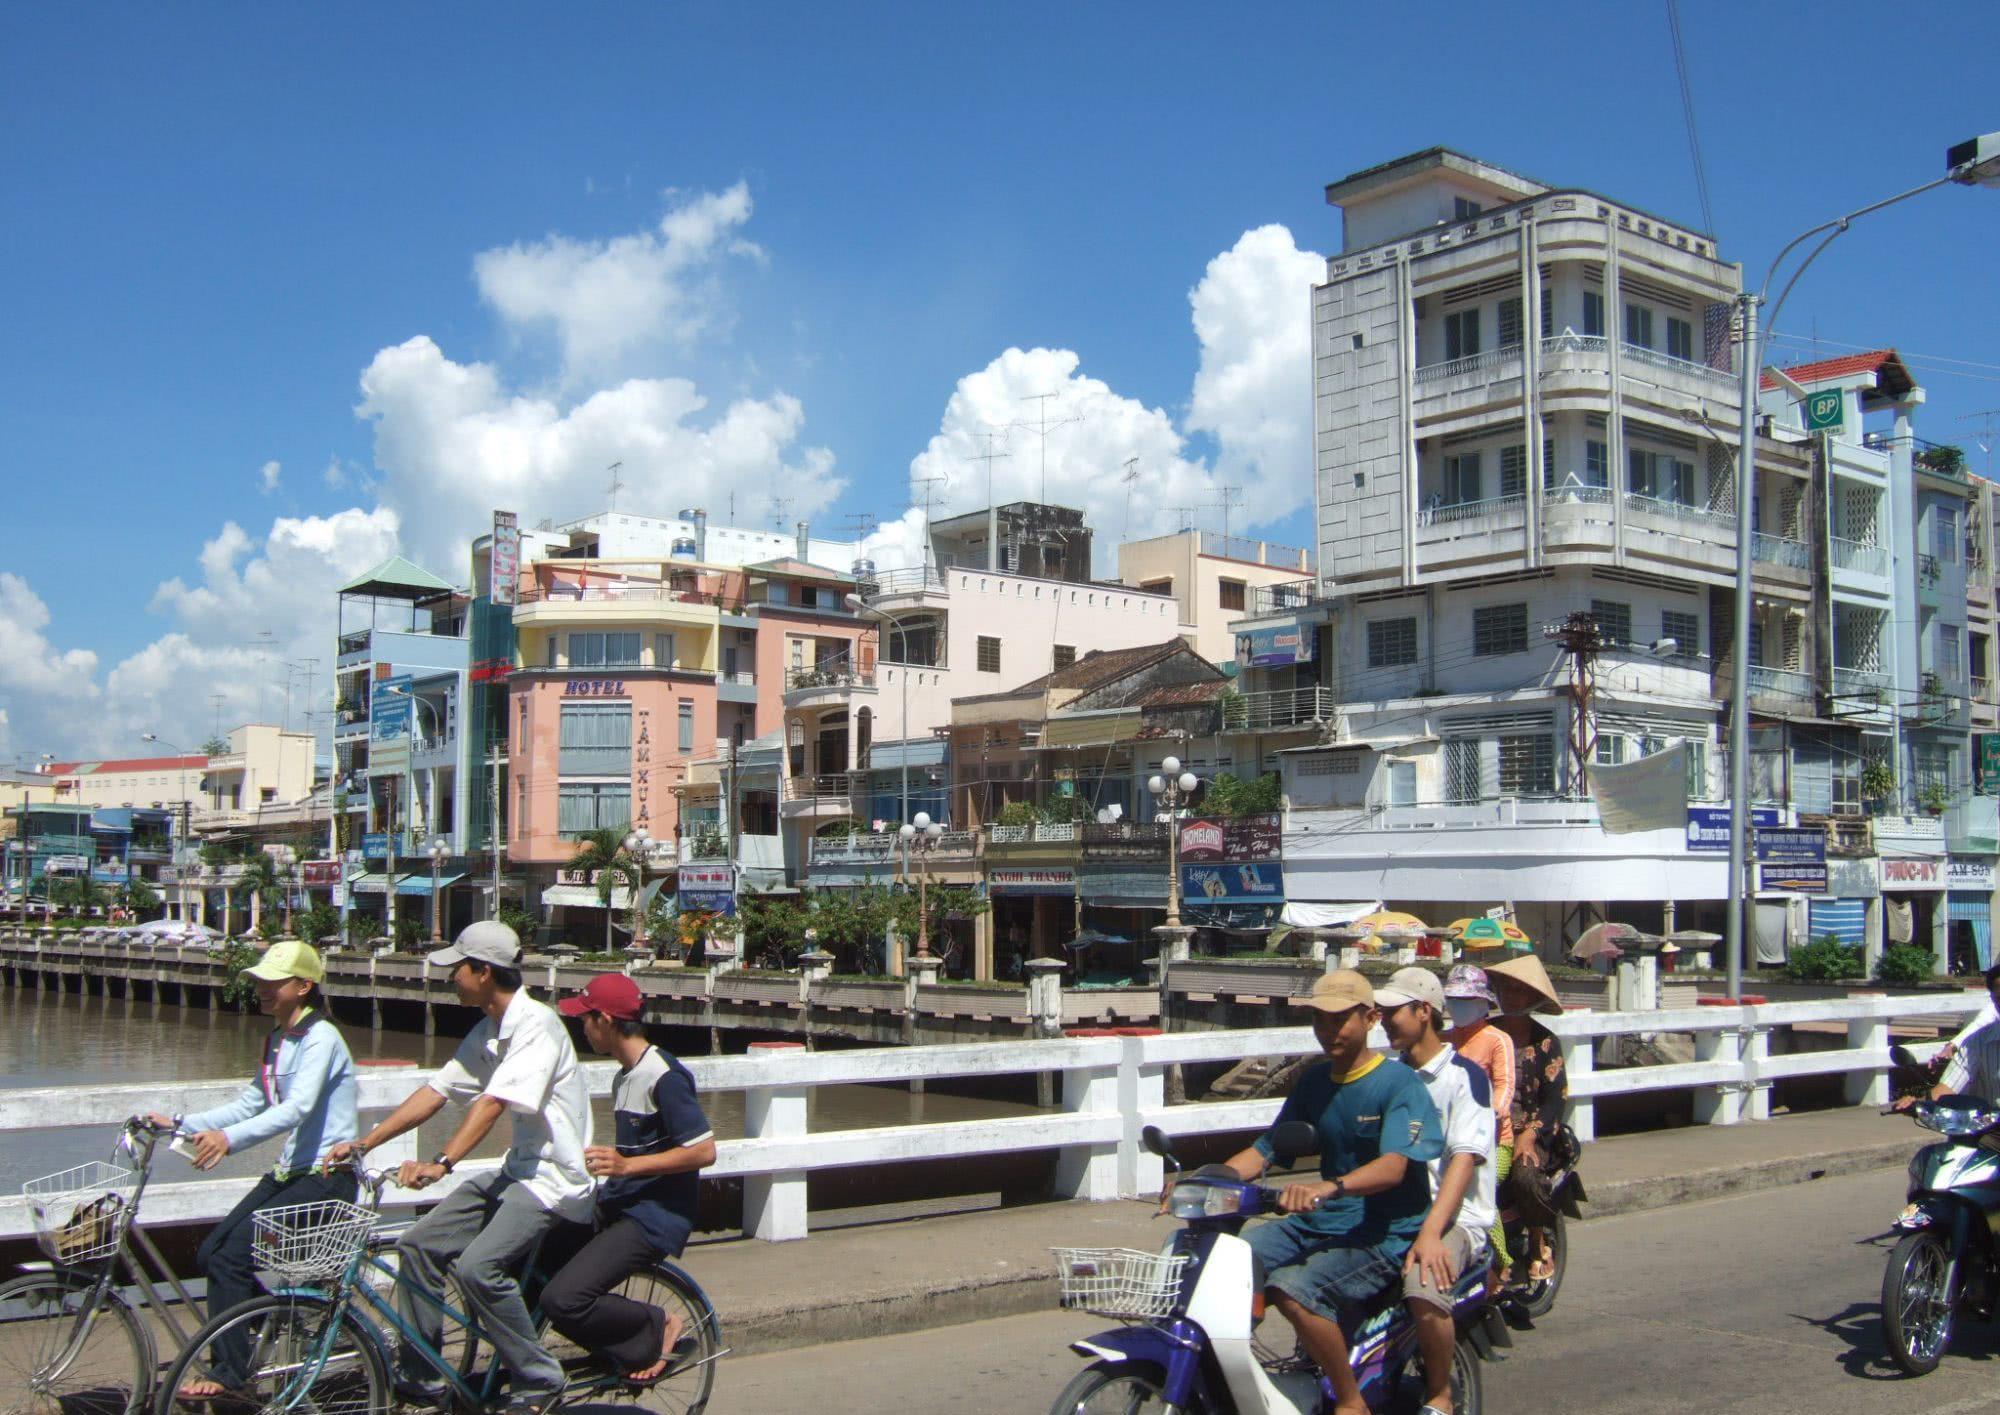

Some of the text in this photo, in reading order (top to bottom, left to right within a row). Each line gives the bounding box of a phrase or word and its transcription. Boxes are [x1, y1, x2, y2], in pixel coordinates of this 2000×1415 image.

[1817, 399, 1836, 416] BP
[564, 680, 625, 696] HOTEL
[1184, 828, 1220, 845] HOMELAND
